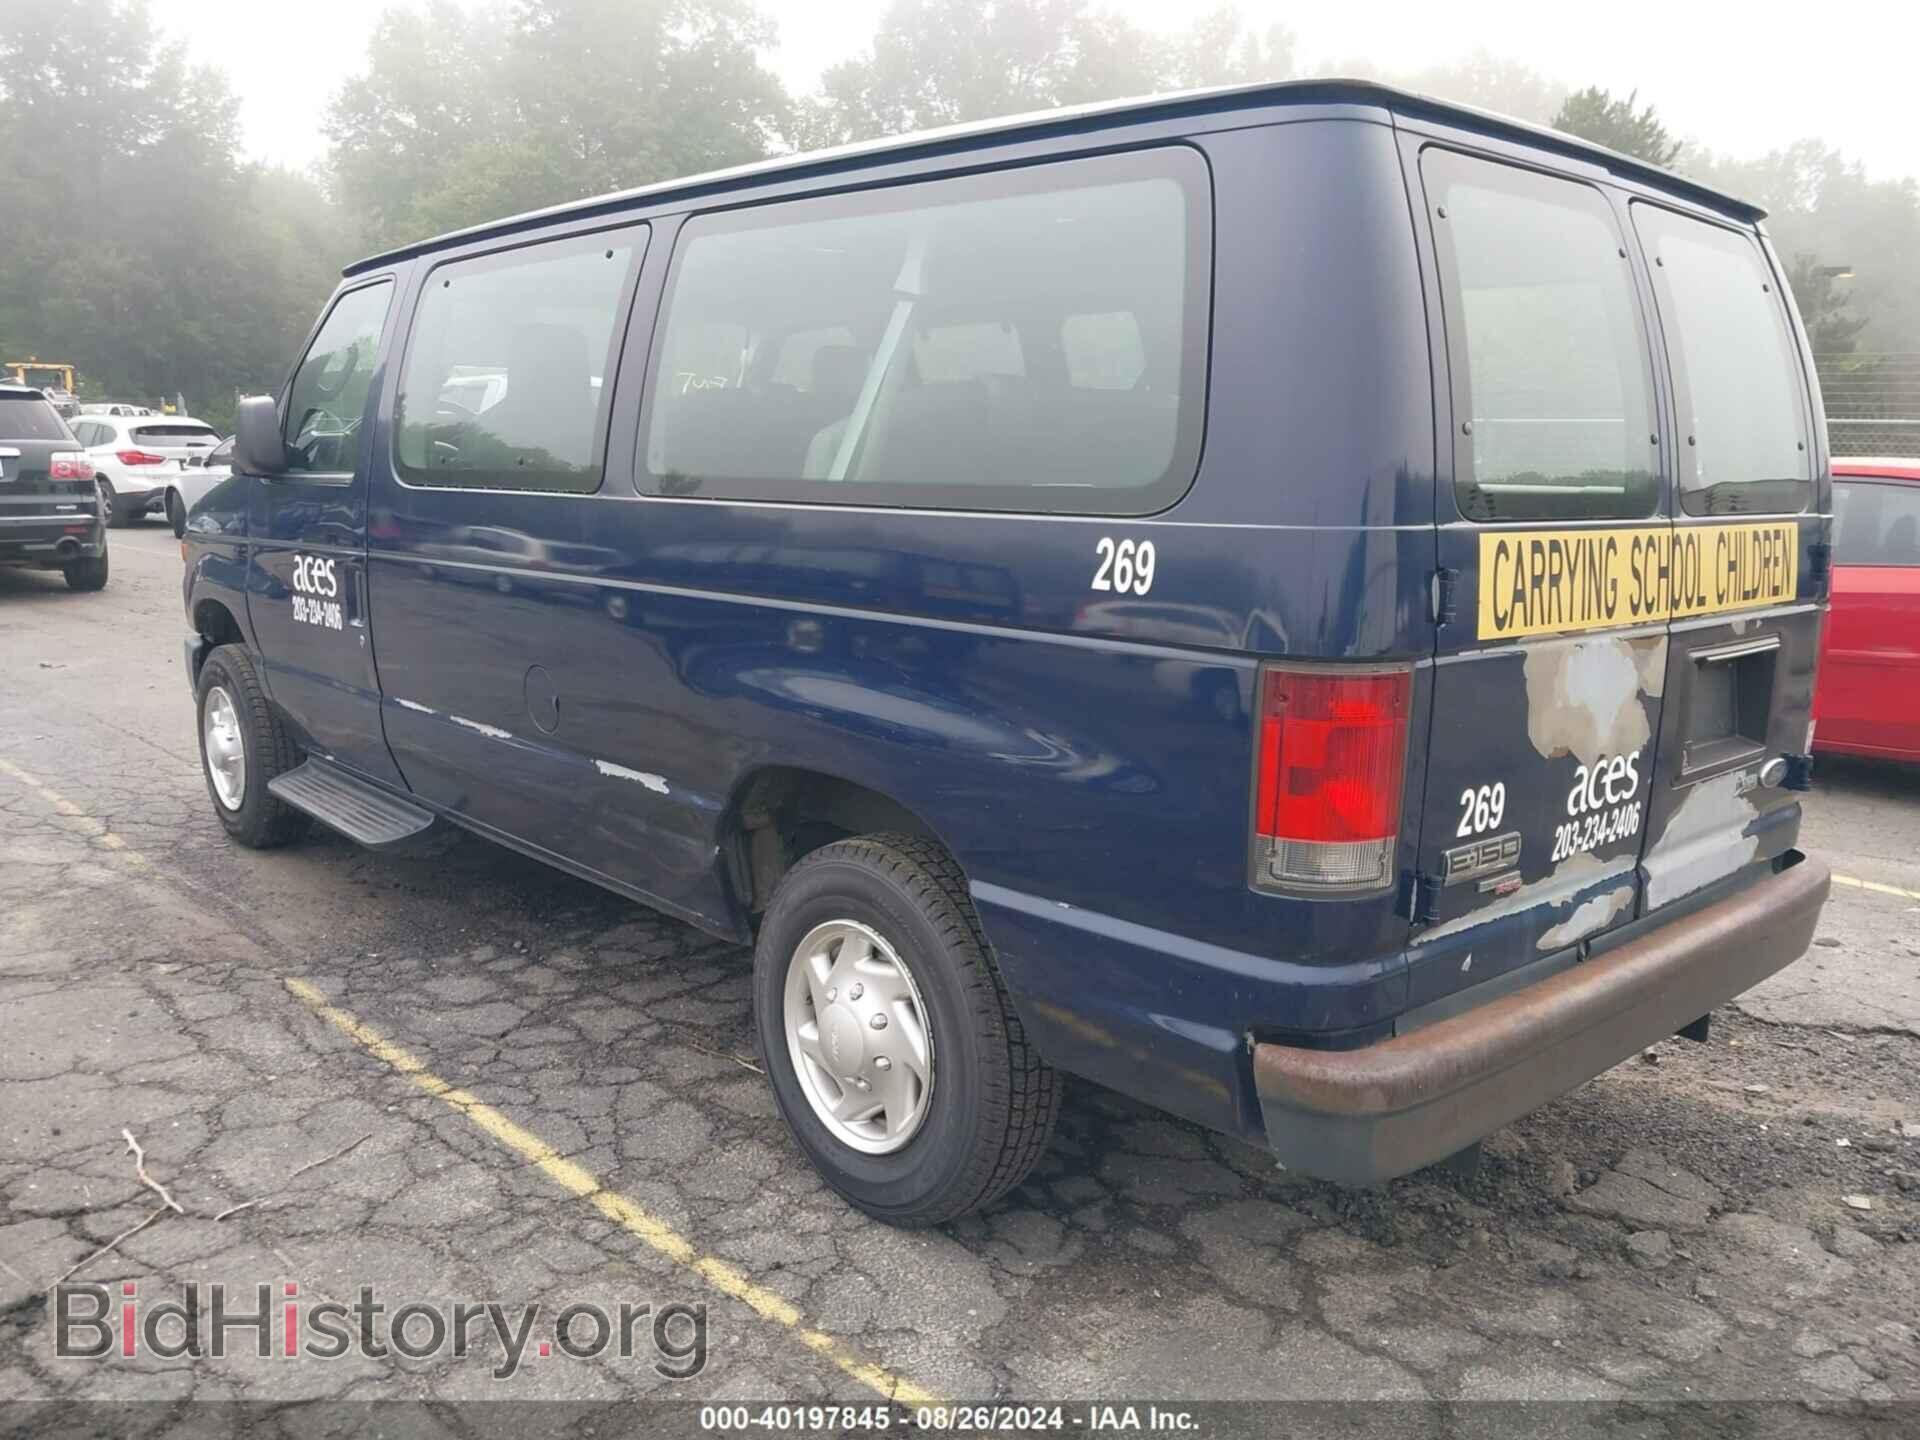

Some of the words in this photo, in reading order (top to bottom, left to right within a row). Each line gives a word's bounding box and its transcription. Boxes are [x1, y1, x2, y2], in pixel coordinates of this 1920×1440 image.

[292, 554, 337, 598] aces
[1090, 536, 1156, 596] 269
[1493, 535, 1618, 631] CARRYING
[1629, 532, 1706, 617] SCHOOL
[1715, 527, 1793, 606] CHILDREN
[1455, 781, 1506, 838] 269
[1566, 750, 1641, 817] aces
[1551, 800, 1642, 863] 203-234-2406
